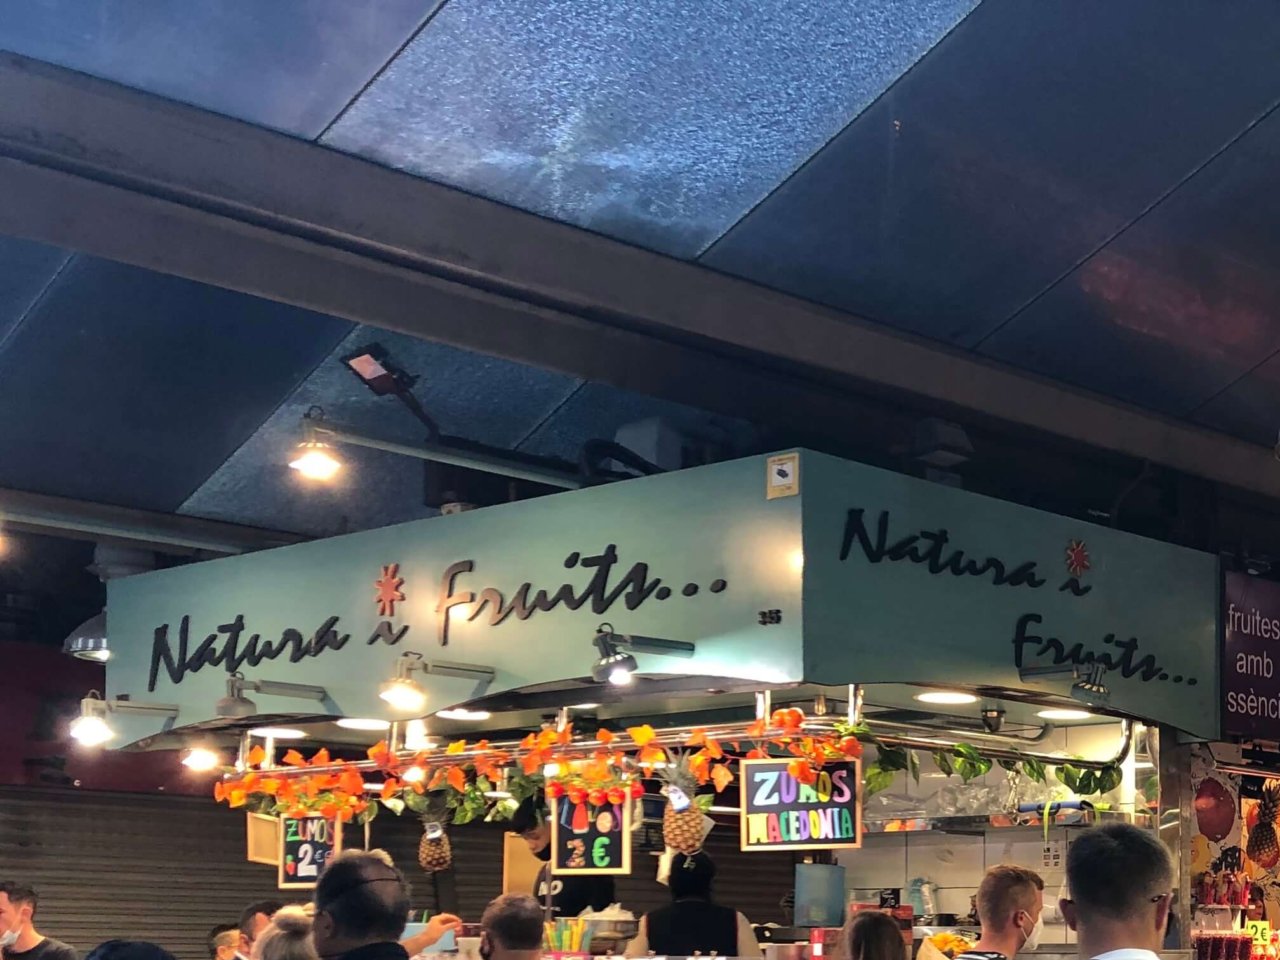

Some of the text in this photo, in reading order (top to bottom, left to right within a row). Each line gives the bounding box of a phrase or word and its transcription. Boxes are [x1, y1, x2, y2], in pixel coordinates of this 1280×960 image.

[839, 507, 1047, 588] Natura
[1227, 603, 1280, 640] fruites
[148, 613, 351, 692] Natura
[1236, 650, 1274, 679] amb
[753, 769, 851, 807] ZUMOS
[285, 819, 334, 846] ZUMOS
[746, 807, 854, 844] MACEDONIA
